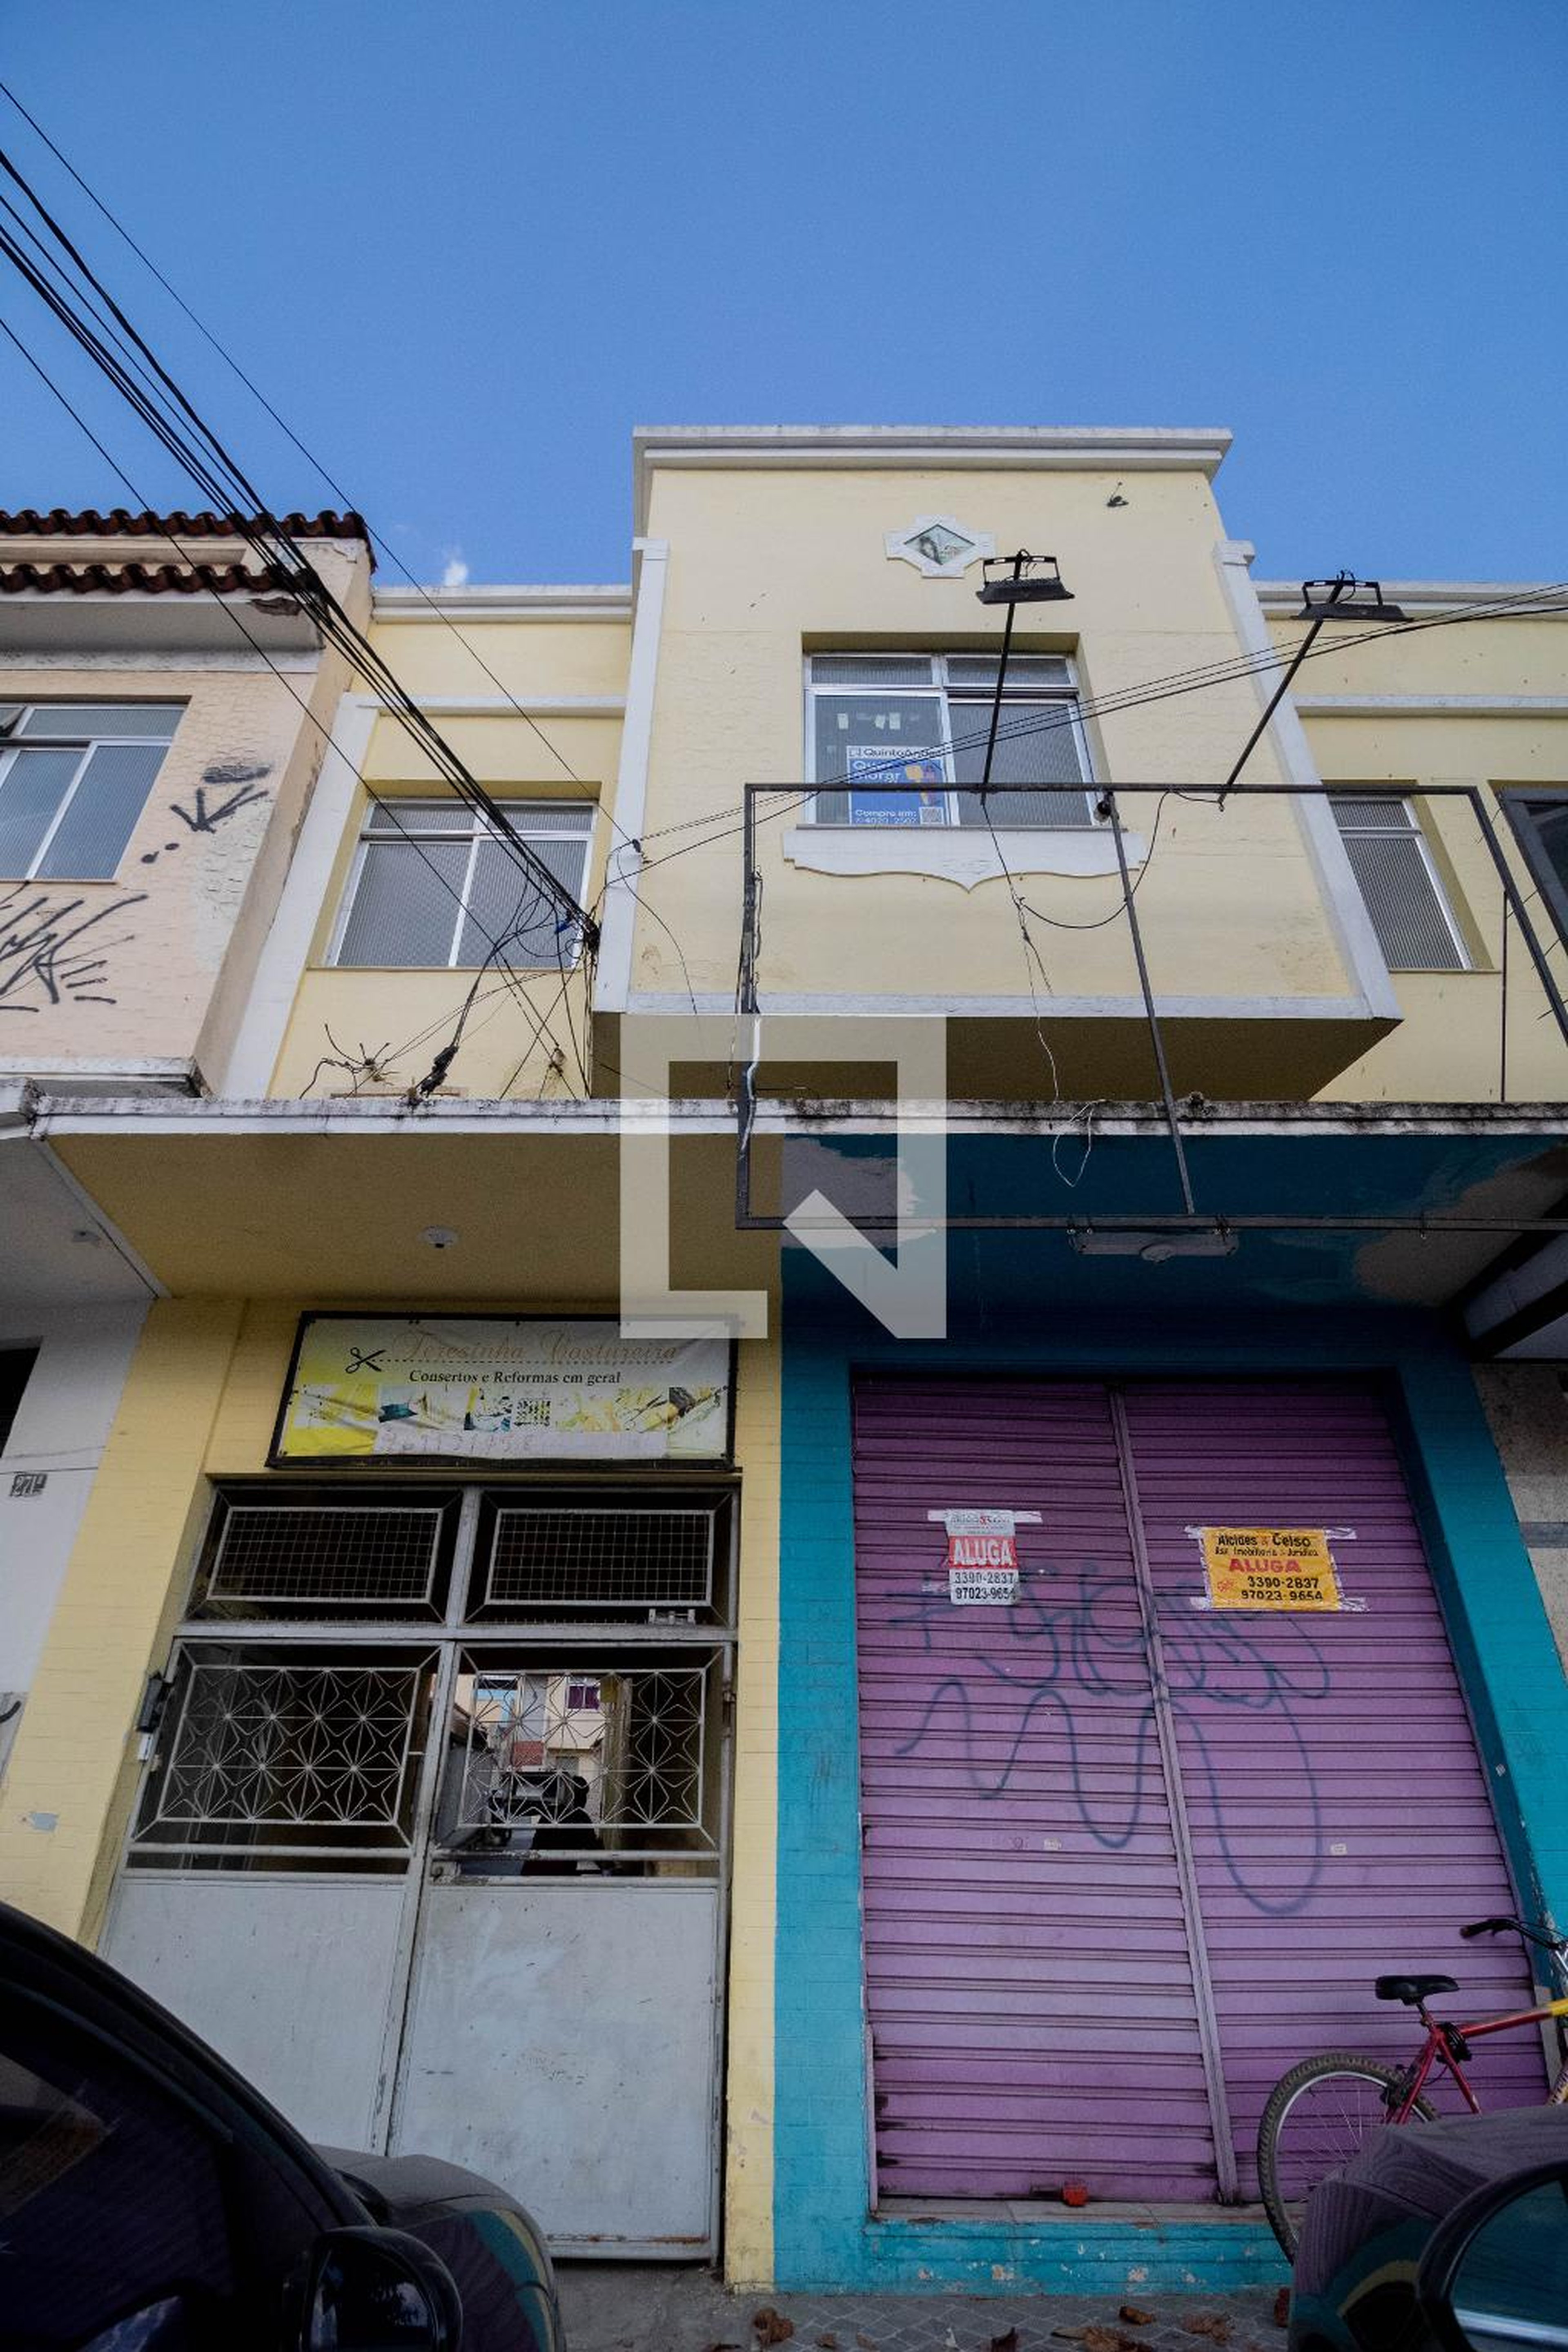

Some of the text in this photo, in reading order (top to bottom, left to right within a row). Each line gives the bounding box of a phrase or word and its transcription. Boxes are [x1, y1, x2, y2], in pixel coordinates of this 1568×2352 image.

[409, 1370, 620, 1386] Consertos e Reformas em geral
[1218, 1534, 1258, 1546] Alcides
[1272, 1532, 1311, 1547] Celso
[953, 1539, 1013, 1566] ALUGA
[1229, 1558, 1301, 1572] ALUGA
[955, 1572, 1014, 1584] 3390-2837
[1247, 1576, 1319, 1588] 3390-2837
